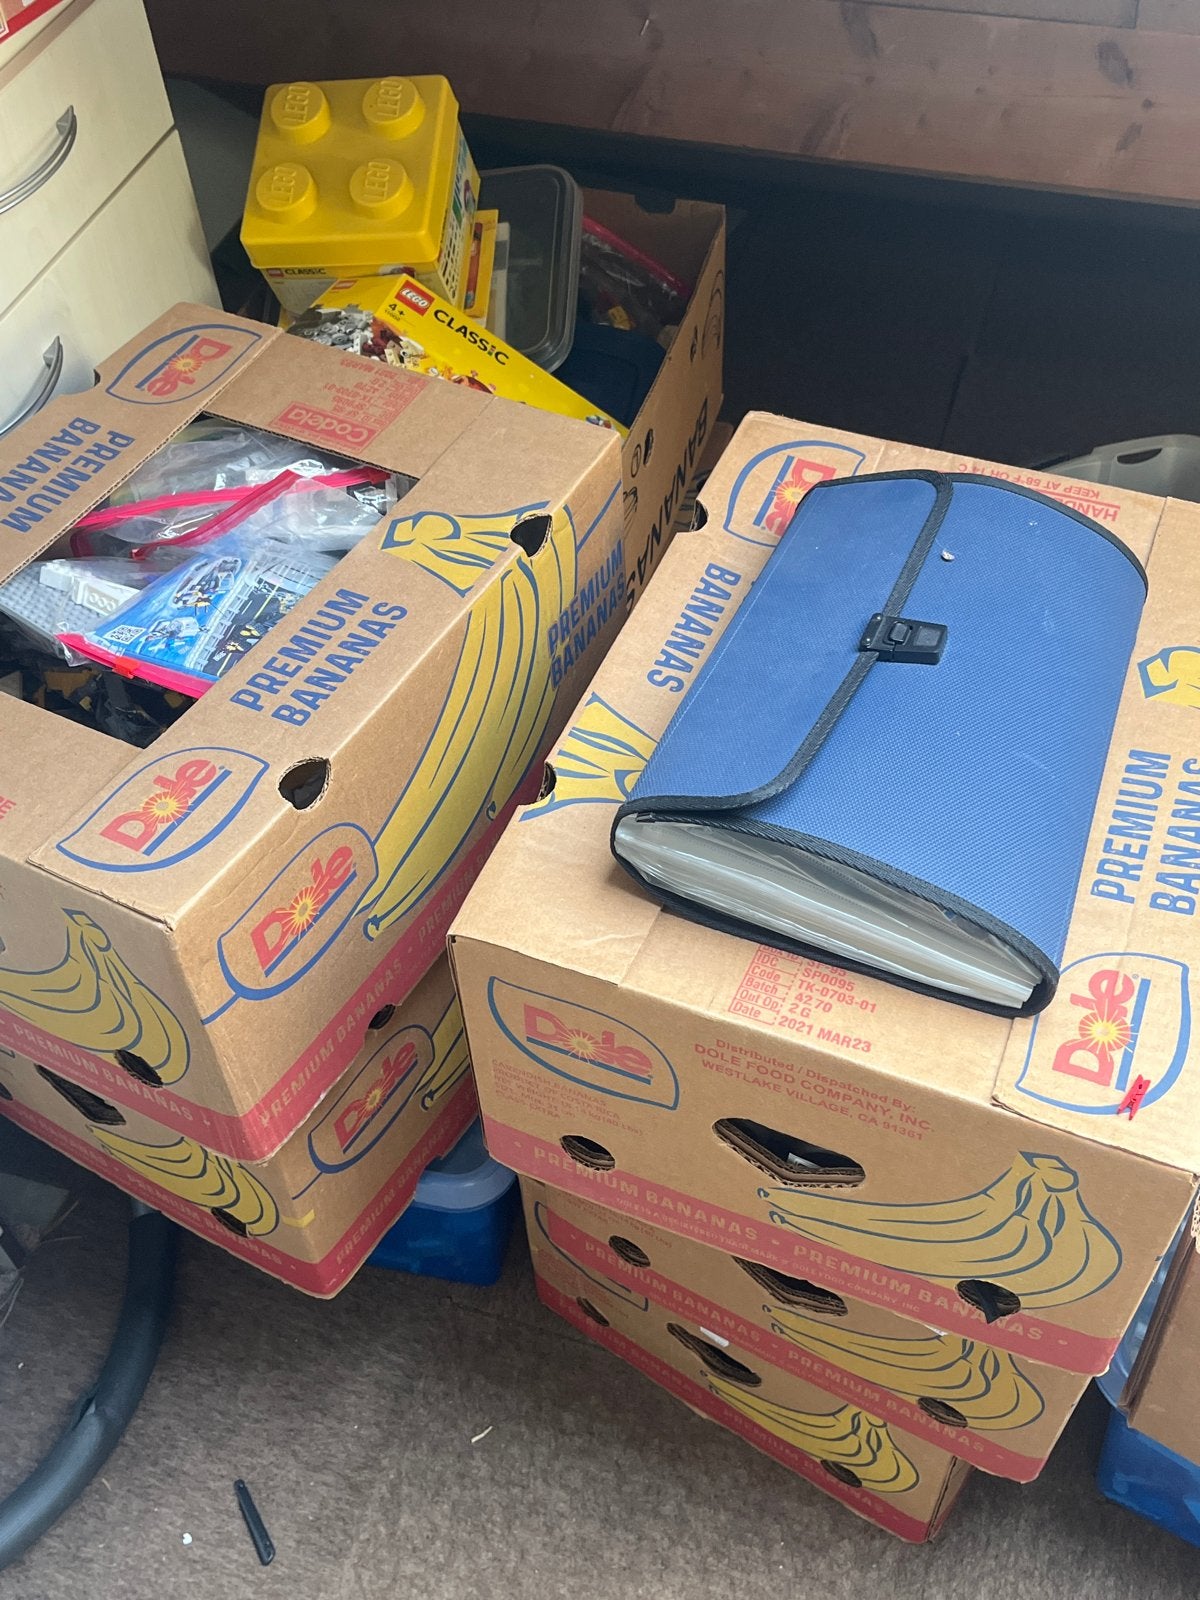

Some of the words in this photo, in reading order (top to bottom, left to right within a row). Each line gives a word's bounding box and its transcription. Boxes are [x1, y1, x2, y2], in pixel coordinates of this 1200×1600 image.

[283, 85, 311, 123] LEGO
[377, 79, 403, 118] LEGO
[271, 166, 298, 204] LEGO
[364, 161, 391, 201] LEGO
[284, 268, 327, 276] CLASSIC
[400, 287, 429, 308] LEGO
[433, 309, 510, 365] CLASSIC
[147, 337, 233, 396] Dole
[287, 408, 368, 442] Codela
[1, 430, 136, 533] PREMIUM
[991, 470, 1010, 480] OR
[1044, 479, 1062, 490] AT
[1053, 496, 1118, 522] HAND
[1064, 486, 1100, 499] KEEP
[547, 539, 624, 658] PREMIUM
[551, 572, 626, 690] BANANAS
[646, 563, 742, 693] BANANAS
[230, 588, 370, 712] PREMIUM
[271, 602, 408, 727] BANANAS
[100, 759, 217, 852] Dole
[1090, 748, 1172, 905] PREMIUM
[251, 846, 353, 975] Dole
[336, 958, 403, 1045] BANANAS
[738, 990, 760, 1004] Out
[744, 977, 779, 996] Batch
[749, 965, 782, 982] Code
[797, 979, 878, 1013] TK-0703-01
[756, 952, 779, 968] IDC
[802, 967, 857, 992] SP0095
[523, 1003, 653, 1077] Dole
[732, 1001, 762, 1018] Date
[778, 1015, 814, 1036] 2021
[817, 1027, 873, 1053] MAR23
[1052, 969, 1136, 1087] Dole
[12, 1022, 100, 1076] PREMIUM
[101, 1067, 195, 1122] BANANAS
[259, 1042, 335, 1129] PREMIUM
[333, 1041, 417, 1150] Dole
[693, 1043, 742, 1067] DOLE
[746, 1061, 797, 1084] FOOD
[800, 1079, 895, 1120] COMPANY,
[899, 1112, 936, 1133] INC.
[701, 1059, 783, 1093] WESTLAKE
[785, 1087, 854, 1118] VILLAGE,
[857, 1112, 880, 1127] CA
[882, 1121, 924, 1141] 91361
[716, 1038, 795, 1072] Distributed
[805, 1069, 889, 1104] Dispatched
[891, 1098, 916, 1114] By:
[336, 1189, 397, 1265] PREMIUM
[533, 1146, 640, 1198] PREMIUM
[645, 1189, 760, 1240] BANANAS
[793, 1244, 912, 1297] PREMIUM
[917, 1288, 1045, 1342] BANANAS
[584, 1241, 668, 1295] PREMIUM
[672, 1289, 762, 1343] BANANAS
[787, 1349, 881, 1404] PREMIUM
[885, 1398, 986, 1453] BANANAS
